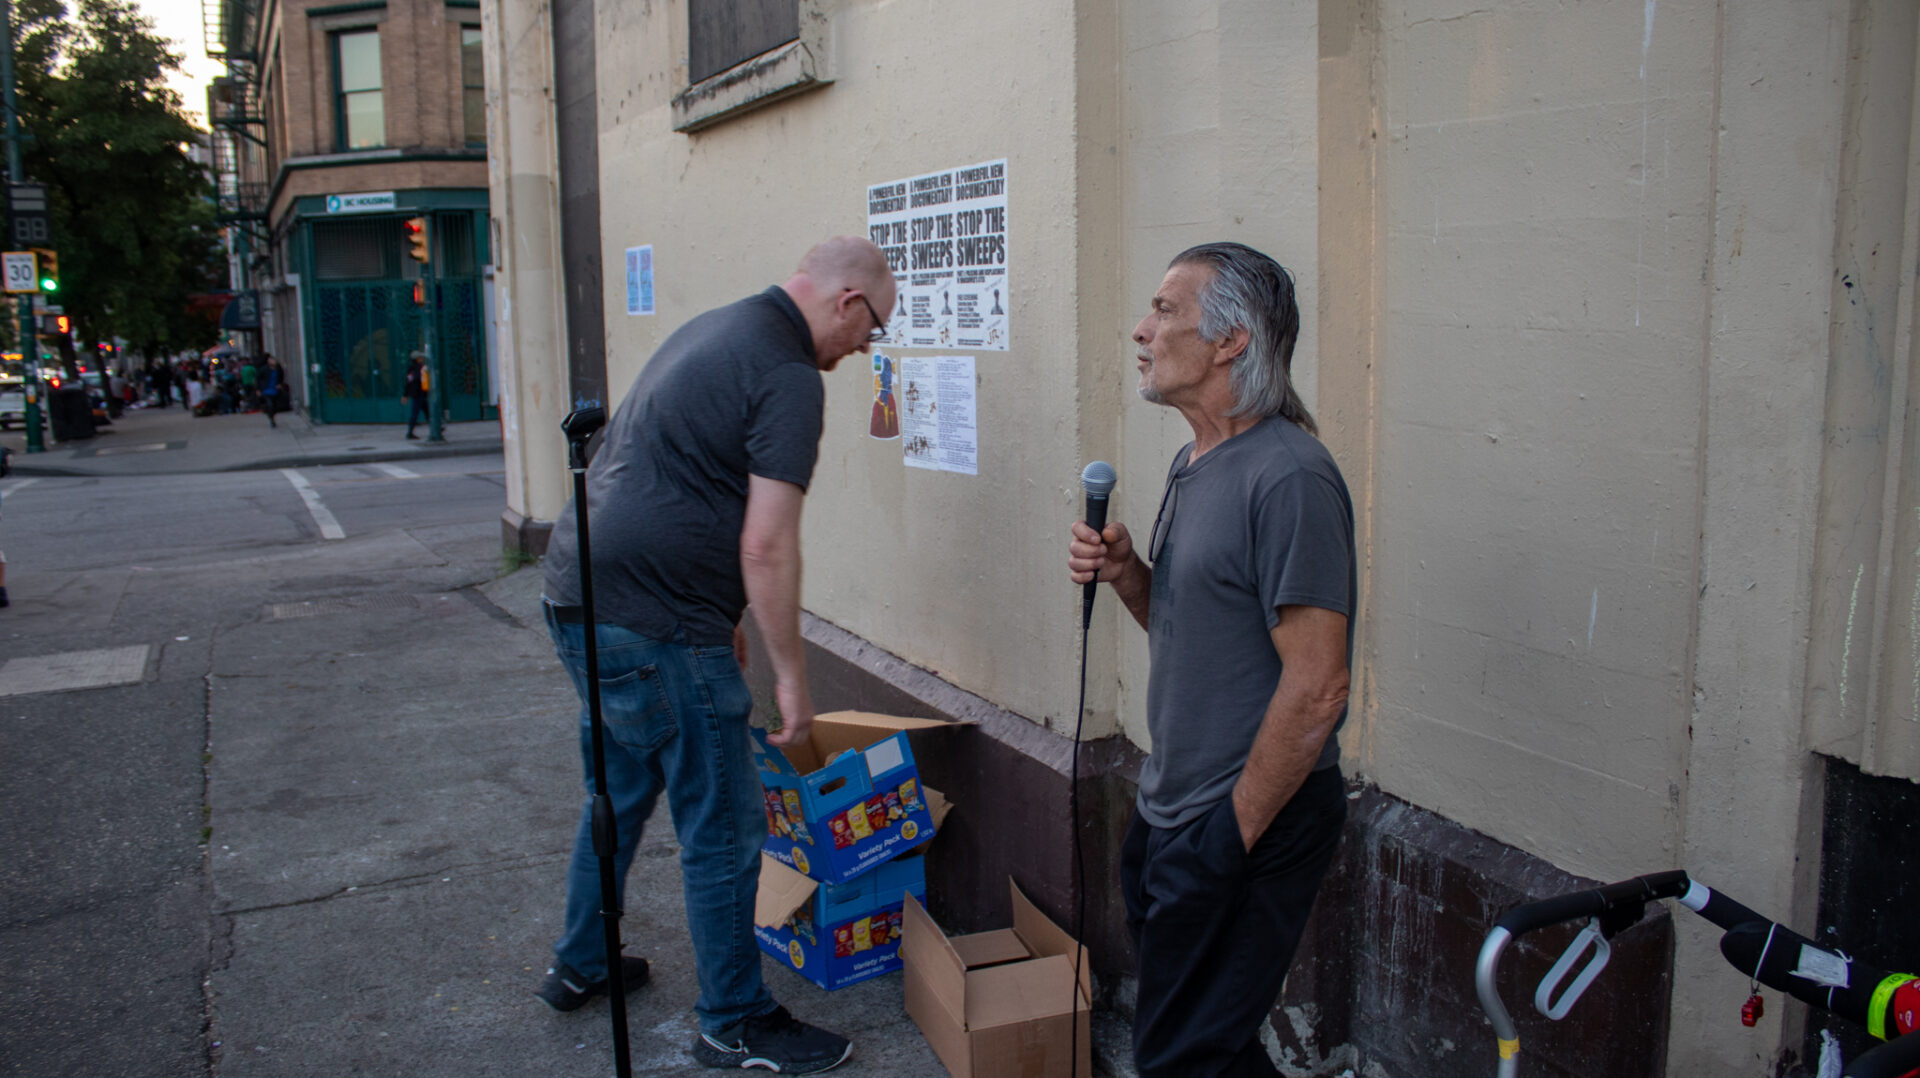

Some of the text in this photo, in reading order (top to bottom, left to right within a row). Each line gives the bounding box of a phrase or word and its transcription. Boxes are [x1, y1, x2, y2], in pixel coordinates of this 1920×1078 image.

[940, 173, 952, 188] NEW
[961, 165, 989, 184] POWERFUL
[990, 163, 1004, 179] NEW
[910, 187, 953, 209] DOCUMENTARY
[956, 178, 1005, 201] DOCUMENTARY
[869, 196, 907, 216] DOCUMENTARY
[870, 220, 907, 248] STOP THE
[910, 213, 953, 242] STOP THE
[957, 206, 1005, 237] STOP THE
[882, 244, 907, 272] EEPS
[911, 239, 953, 271] SWEEPS
[957, 234, 1005, 268] SWEEPS
[10, 263, 32, 281] 30
[858, 843, 883, 860] Variety
[884, 833, 901, 848] Pack
[772, 937, 788, 954] Pack
